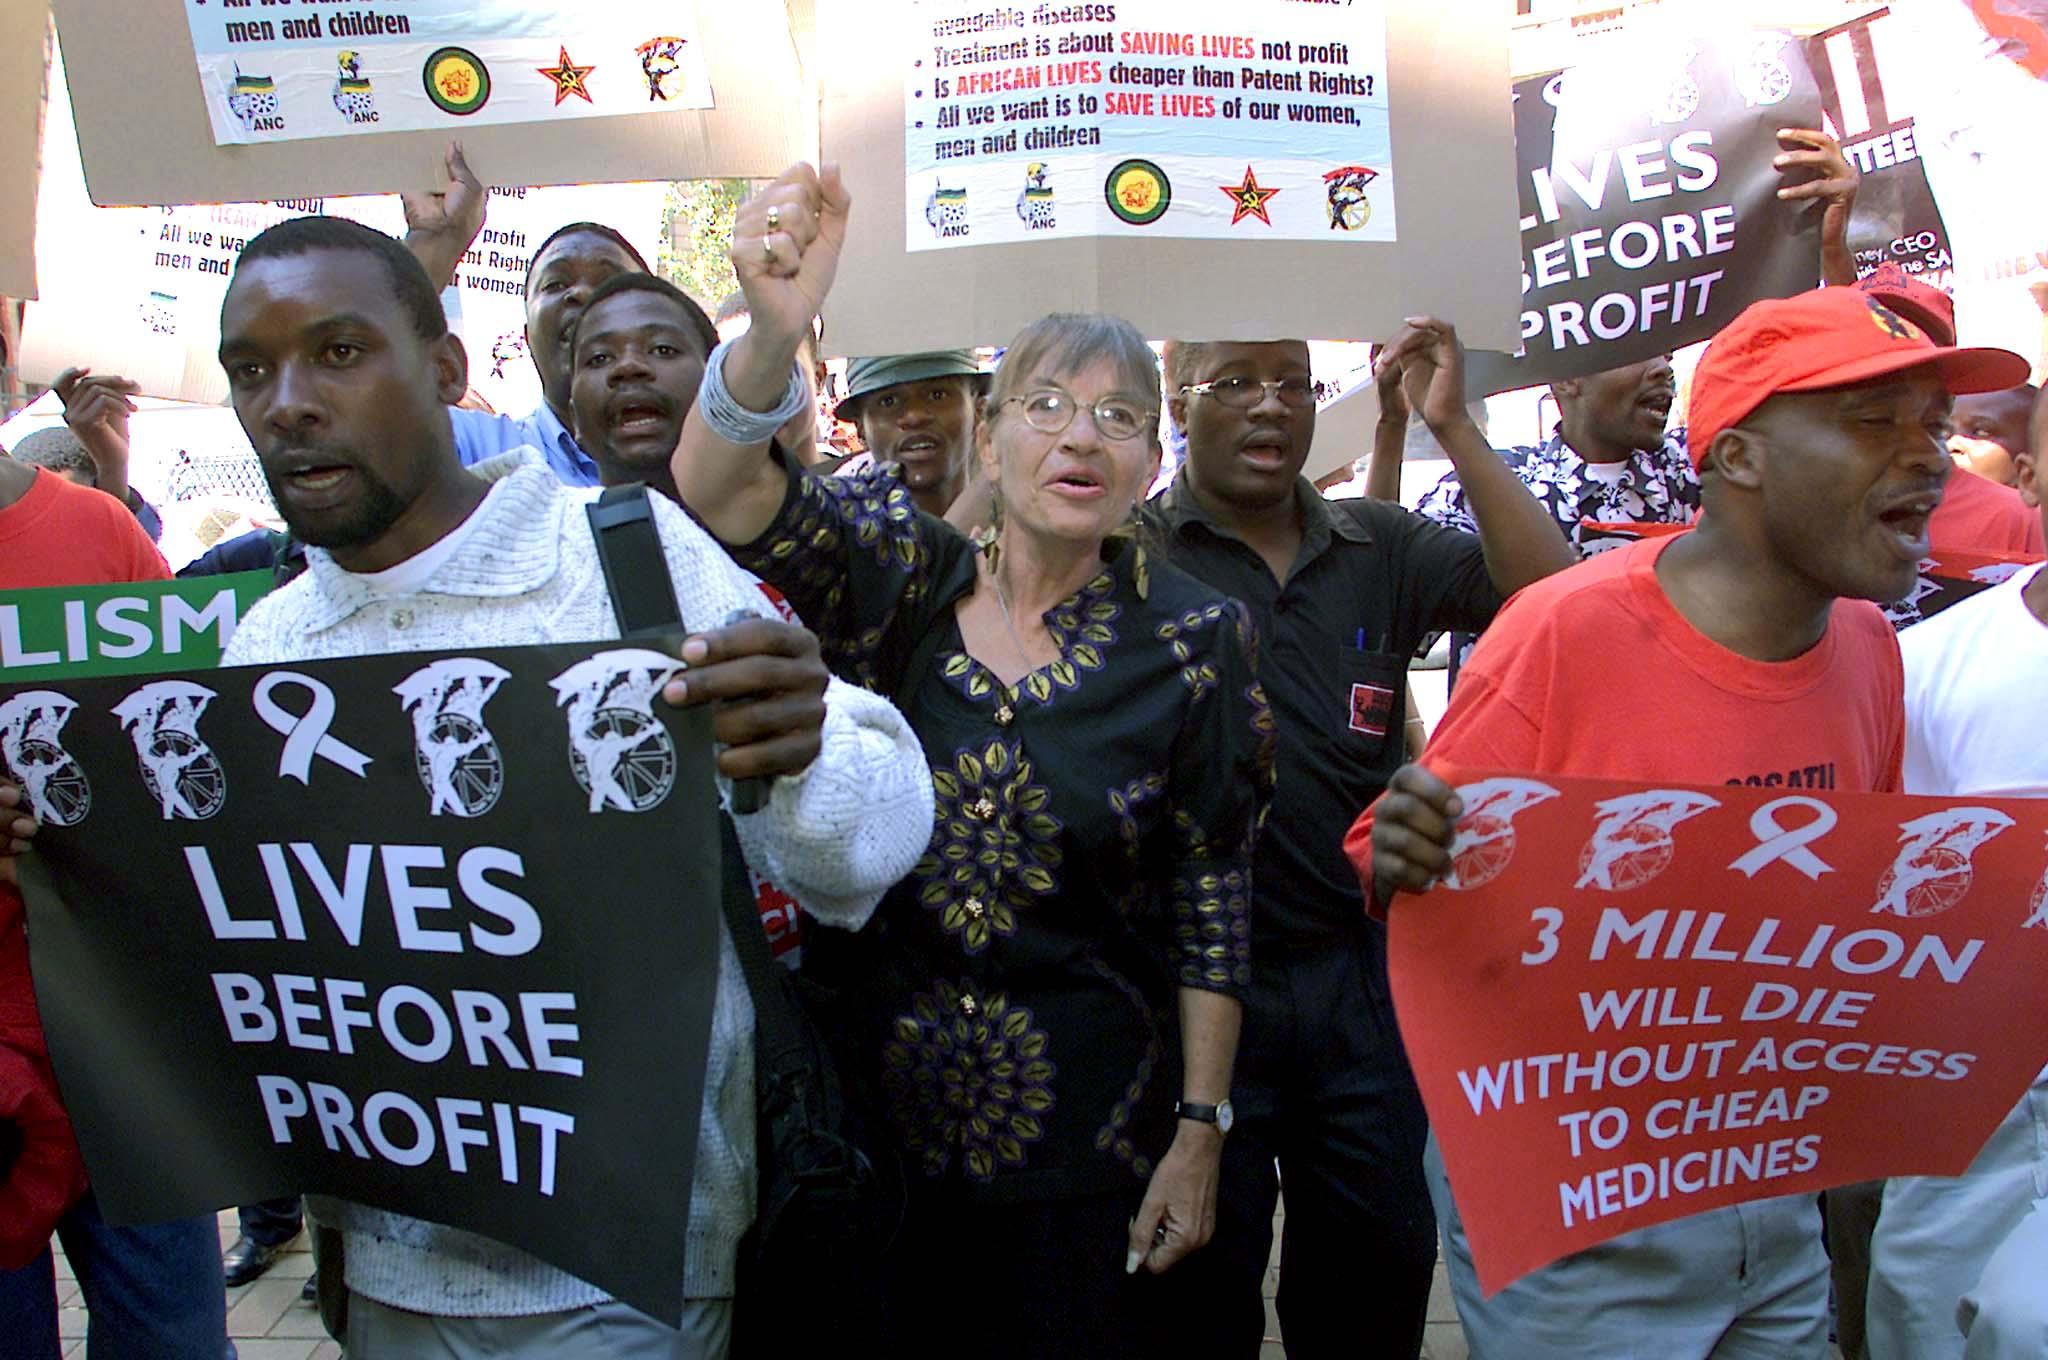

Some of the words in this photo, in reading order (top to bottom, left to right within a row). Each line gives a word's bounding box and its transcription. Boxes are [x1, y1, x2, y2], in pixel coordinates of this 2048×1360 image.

[226, 19, 275, 43] men
[282, 13, 322, 40] and
[328, 11, 411, 37] children
[1032, 3, 1117, 26] diseases
[934, 37, 1029, 68] Treatment
[1036, 34, 1051, 57] is
[1058, 32, 1115, 54] about
[1120, 31, 1194, 57] SAVING
[1201, 35, 1255, 60] LIVES
[1262, 41, 1292, 61] not
[1299, 43, 1349, 65] profit
[934, 78, 949, 99] Is
[956, 65, 1041, 96] AFRICAN
[1047, 61, 1102, 87] LIVES
[1109, 61, 1185, 88] cheaper
[1193, 65, 1234, 89] than
[1241, 67, 1302, 92] Patent
[1309, 71, 1374, 97] Rights?
[254, 116, 285, 132] ANC
[354, 112, 380, 124] ANC
[936, 105, 960, 129] All
[966, 105, 995, 125] we
[1001, 97, 1049, 121] want
[1055, 94, 1071, 117] is
[1078, 93, 1098, 115] to
[1105, 92, 1154, 117] SAVE
[1161, 94, 1216, 118] LIVES
[1223, 98, 1242, 119] of
[1249, 102, 1280, 121] our
[1288, 104, 1361, 127] women,
[935, 138, 975, 160] men
[982, 129, 1017, 154] and
[1024, 125, 1101, 150] children
[1520, 130, 1719, 231] IVES
[160, 223, 181, 243] All
[188, 230, 213, 247] we
[483, 229, 526, 248] profit
[942, 224, 970, 238] ANC
[1032, 218, 1056, 231] ANC
[1890, 231, 1936, 255] CEO
[155, 252, 191, 270] men
[198, 257, 230, 276] and
[0, 589, 238, 668] LISM
[184, 842, 543, 957] LIVES
[1521, 907, 1564, 966] 3
[1590, 906, 1985, 985] MILLION
[210, 972, 585, 1078] BEFORE
[1579, 985, 1723, 1033] WILL
[1740, 982, 1875, 1030] DIE
[1457, 1039, 1737, 1117] WITHOUT
[1737, 1037, 1977, 1082] ACCESS
[256, 1075, 575, 1198] PROFIT
[1558, 1108, 1629, 1158] TO
[1645, 1085, 1830, 1140] CHEAP
[1559, 1135, 1822, 1229] MEDICINES
